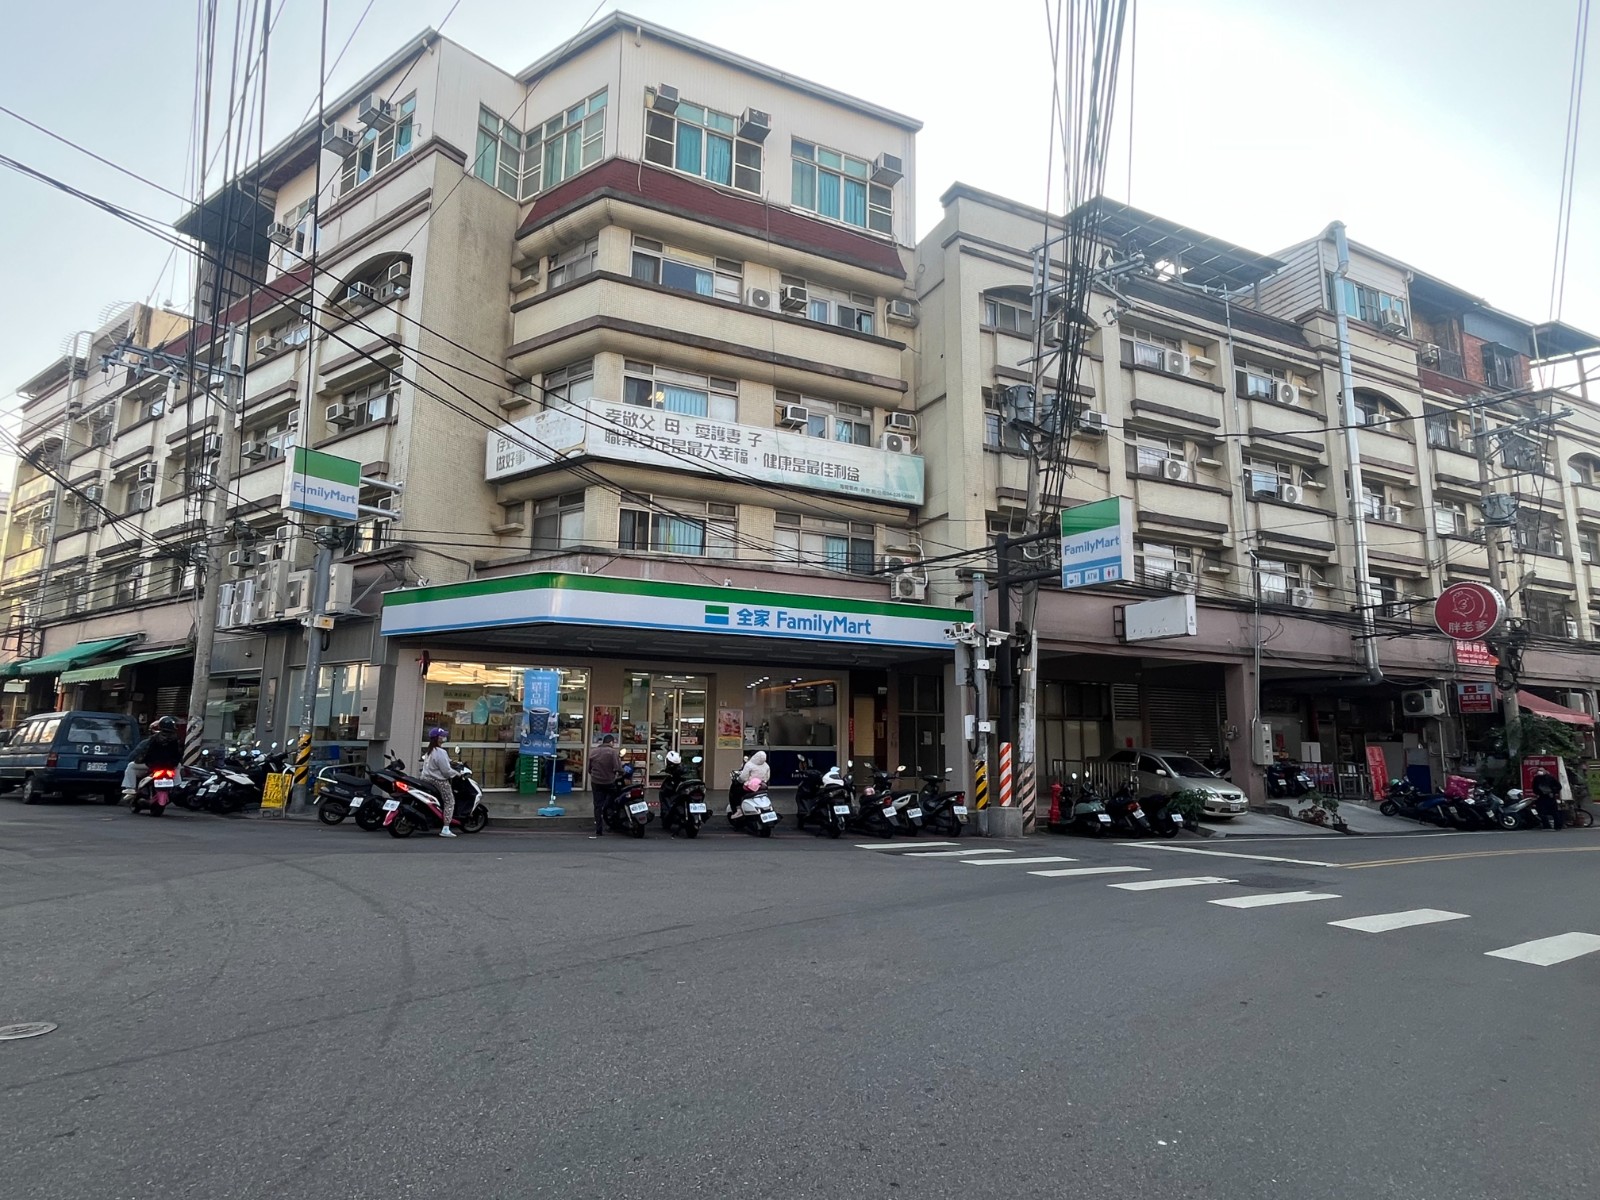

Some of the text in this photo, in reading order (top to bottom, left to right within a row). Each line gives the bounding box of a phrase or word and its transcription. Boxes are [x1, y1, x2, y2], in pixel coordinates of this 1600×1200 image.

[293, 481, 357, 504] FamilyMart
[1064, 535, 1120, 556] FamilyMart
[736, 608, 770, 627] 全家
[776, 610, 872, 635] FamilyMart
[1448, 620, 1488, 634] 胖老爹
